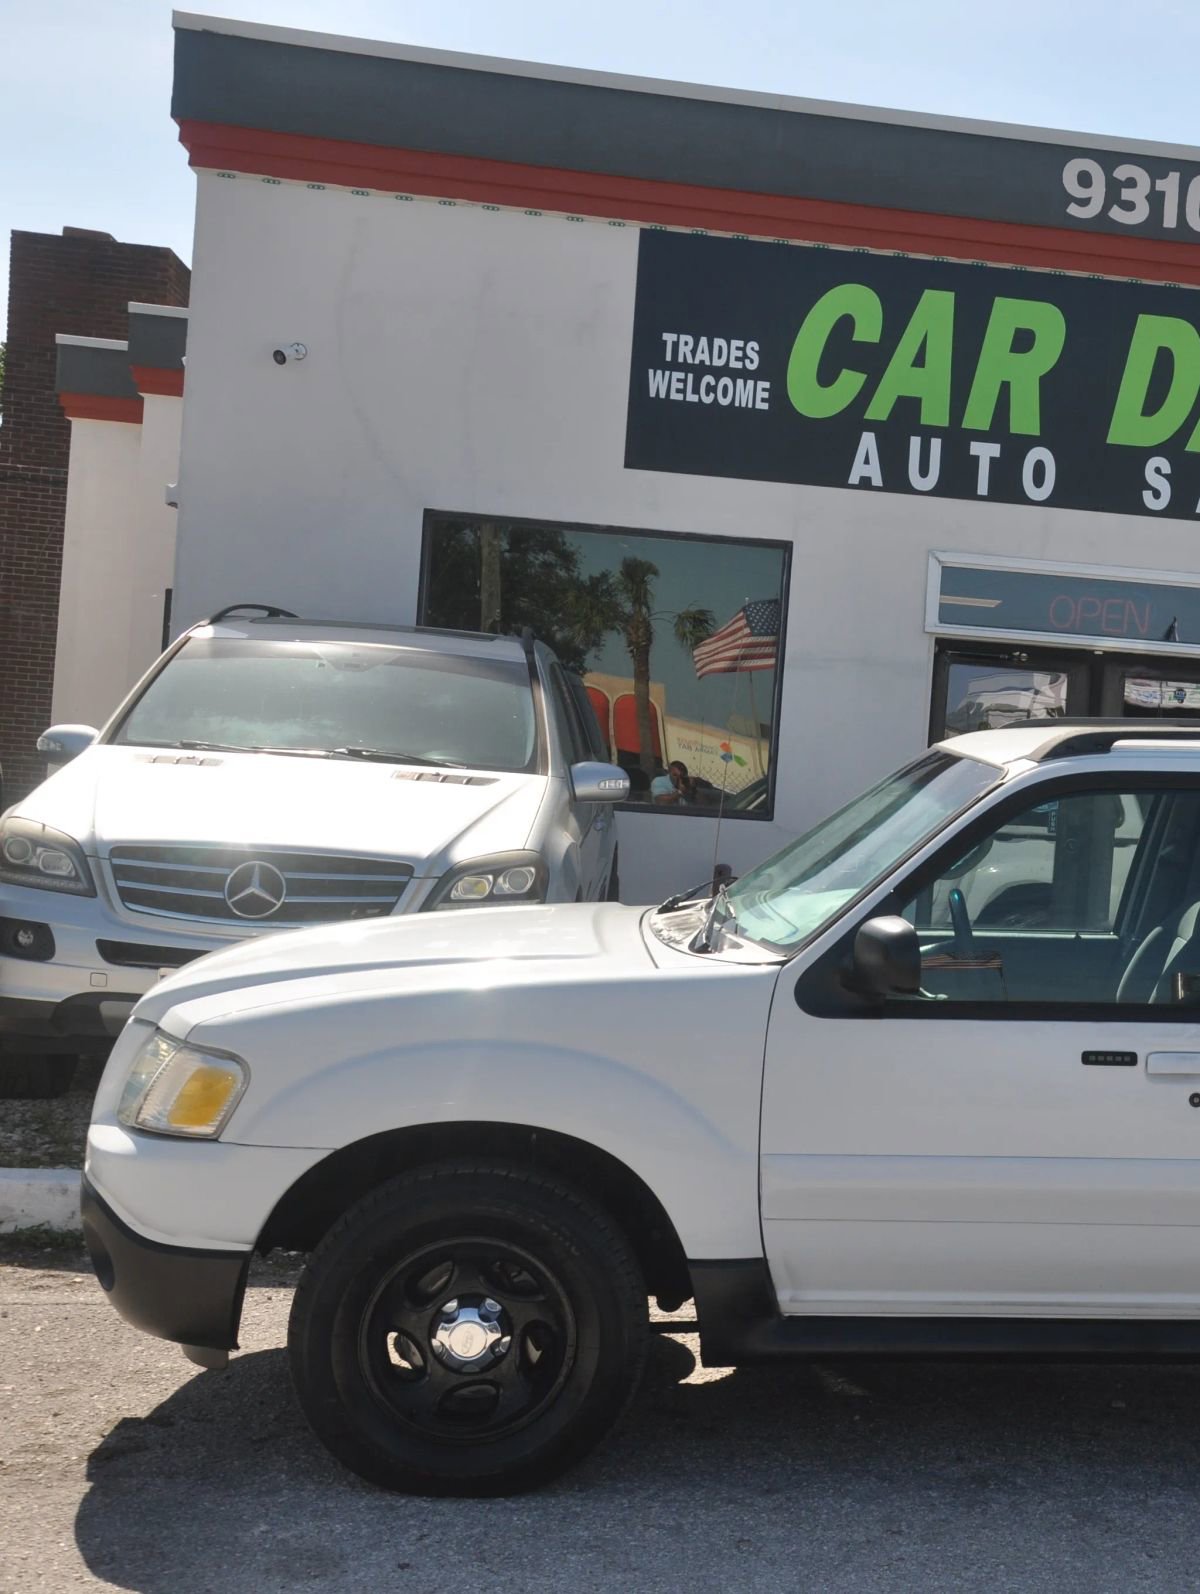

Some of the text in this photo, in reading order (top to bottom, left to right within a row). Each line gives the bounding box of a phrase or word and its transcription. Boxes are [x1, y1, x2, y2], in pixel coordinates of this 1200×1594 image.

[662, 332, 760, 370] TRADES
[786, 283, 1066, 436] CAR
[648, 368, 771, 410] WELCOME
[847, 431, 1056, 502] AUTO
[1049, 595, 1152, 635] OPEN
